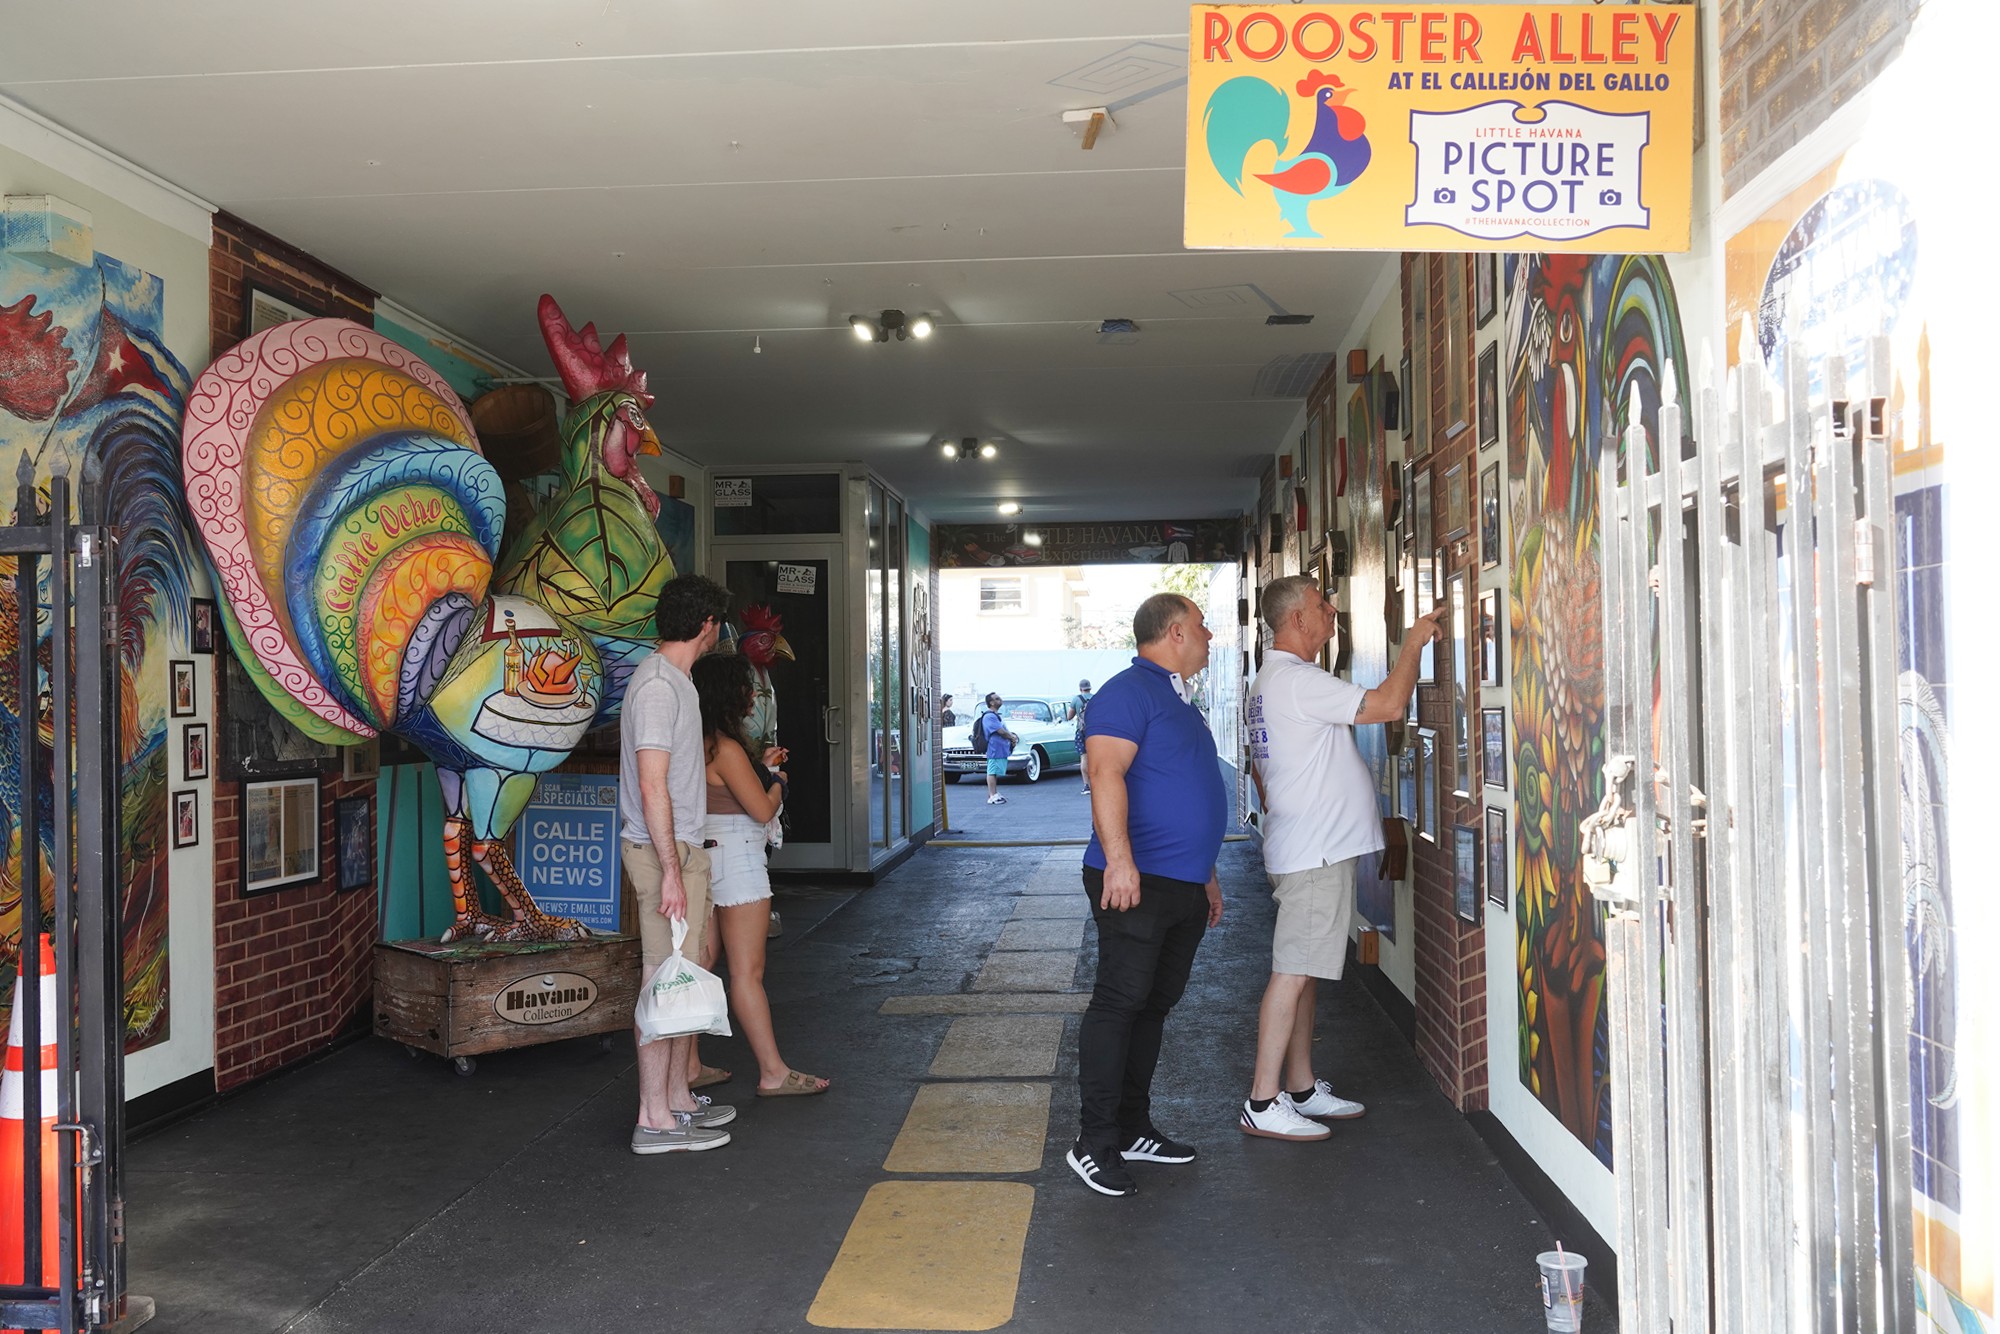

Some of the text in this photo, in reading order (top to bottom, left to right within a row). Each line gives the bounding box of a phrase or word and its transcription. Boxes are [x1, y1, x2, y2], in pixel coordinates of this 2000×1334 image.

[1203, 11, 1681, 64] ROOSTER ALLEY
[1388, 67, 1670, 91] AT EL CALLEJÓN DEL GALLO
[1476, 127, 1583, 139] LITTLE HAVANA
[1443, 141, 1614, 177] PICTURE
[1471, 179, 1584, 214] SPOT
[1465, 217, 1591, 227] #THEHAVANACOLLECTION
[715, 489, 751, 497] GLASS
[984, 532, 1006, 543] The
[1079, 525, 1163, 545] HAVANA
[325, 491, 441, 613] Calle Ocho
[1041, 546, 1129, 563] Experience
[778, 574, 815, 584] GLASS
[544, 783, 561, 792] SCAN
[543, 792, 596, 806] SPECIALS
[533, 821, 604, 841] CALLE
[533, 843, 604, 864] OCHO
[532, 866, 603, 887] NEWS
[540, 902, 614, 915] NEWS? EMAIL US!
[506, 987, 589, 1011] Havana
[523, 1006, 573, 1022] Collection
